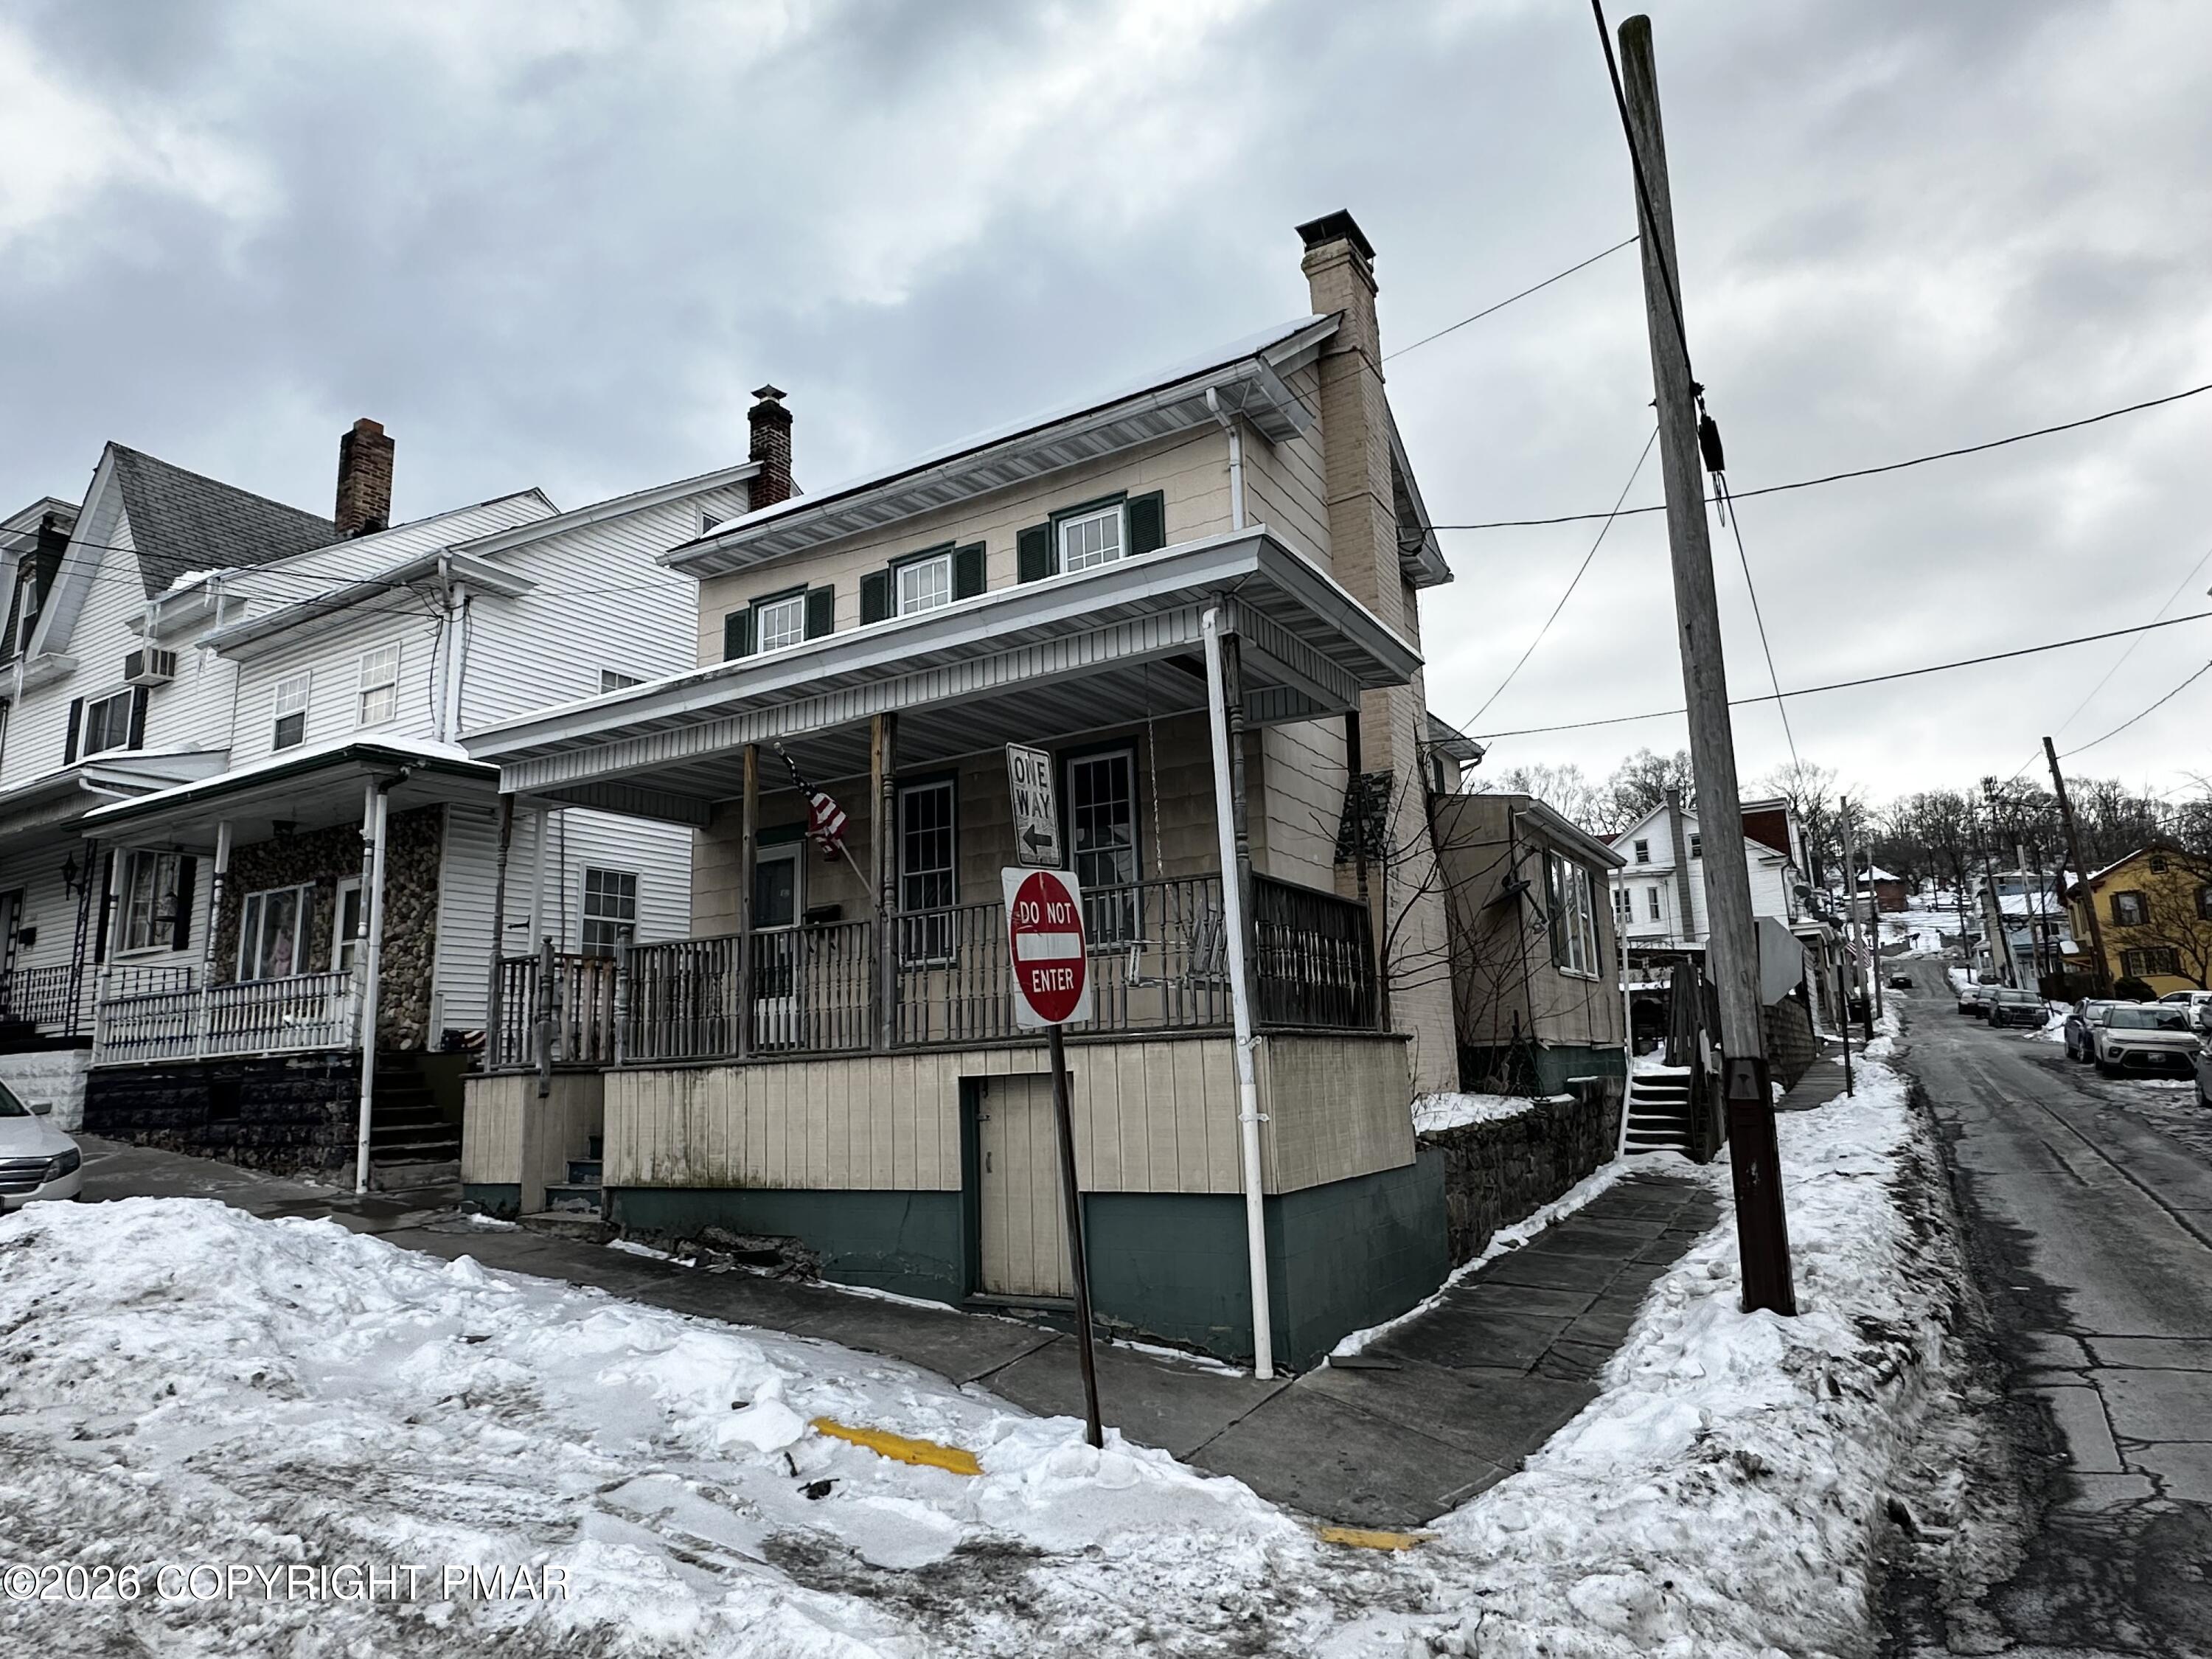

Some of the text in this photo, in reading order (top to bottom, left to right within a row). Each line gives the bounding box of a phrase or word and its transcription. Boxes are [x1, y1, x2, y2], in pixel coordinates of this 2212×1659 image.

[1015, 757, 1047, 787] ONE
[1017, 789, 1049, 819] WAY
[1020, 901, 1071, 924] DO NOT
[1032, 967, 1074, 993] ENTER
